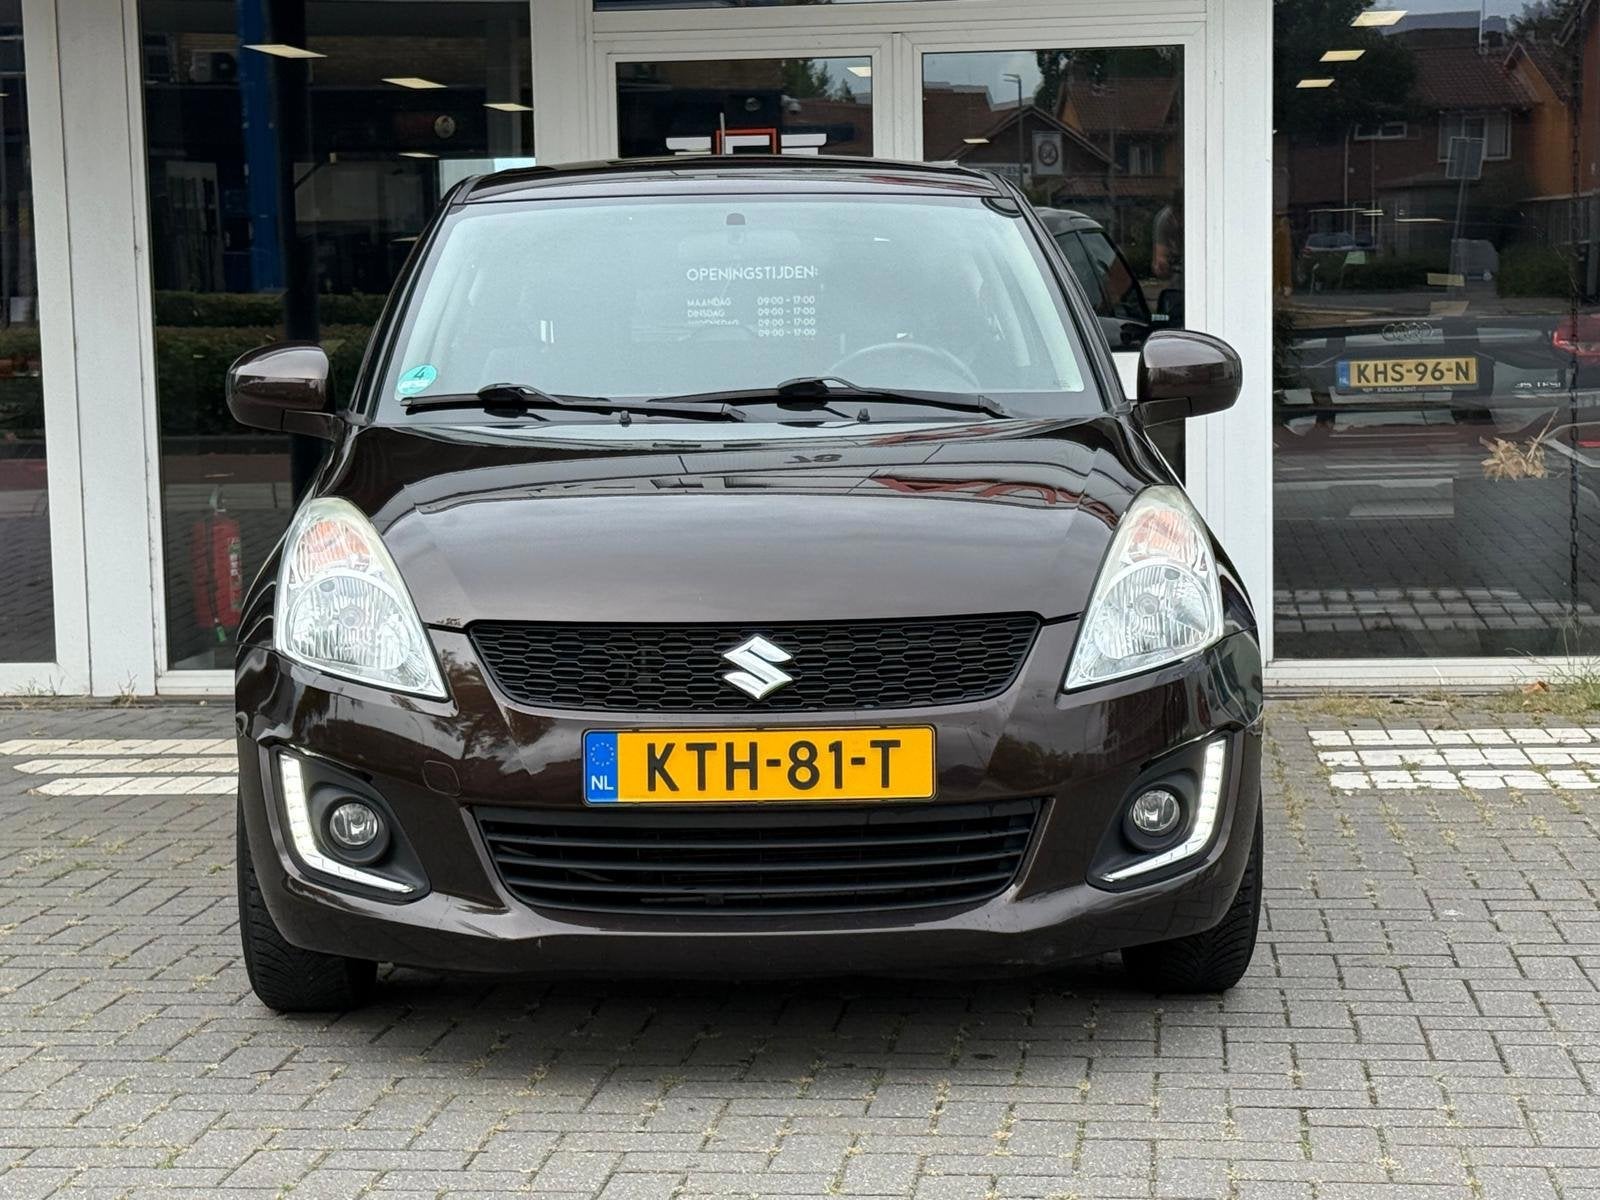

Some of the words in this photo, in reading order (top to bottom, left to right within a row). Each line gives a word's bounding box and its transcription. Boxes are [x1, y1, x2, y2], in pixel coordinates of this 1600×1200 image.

[686, 265, 819, 281] OPENINGSTIJDEN:
[687, 297, 732, 307] MAANDAG
[687, 309, 726, 318] DINSDAG
[413, 366, 426, 380] 4
[1357, 361, 1470, 384] KHS-96-N
[591, 775, 614, 791] NL
[647, 739, 901, 792] KTH-81-T
